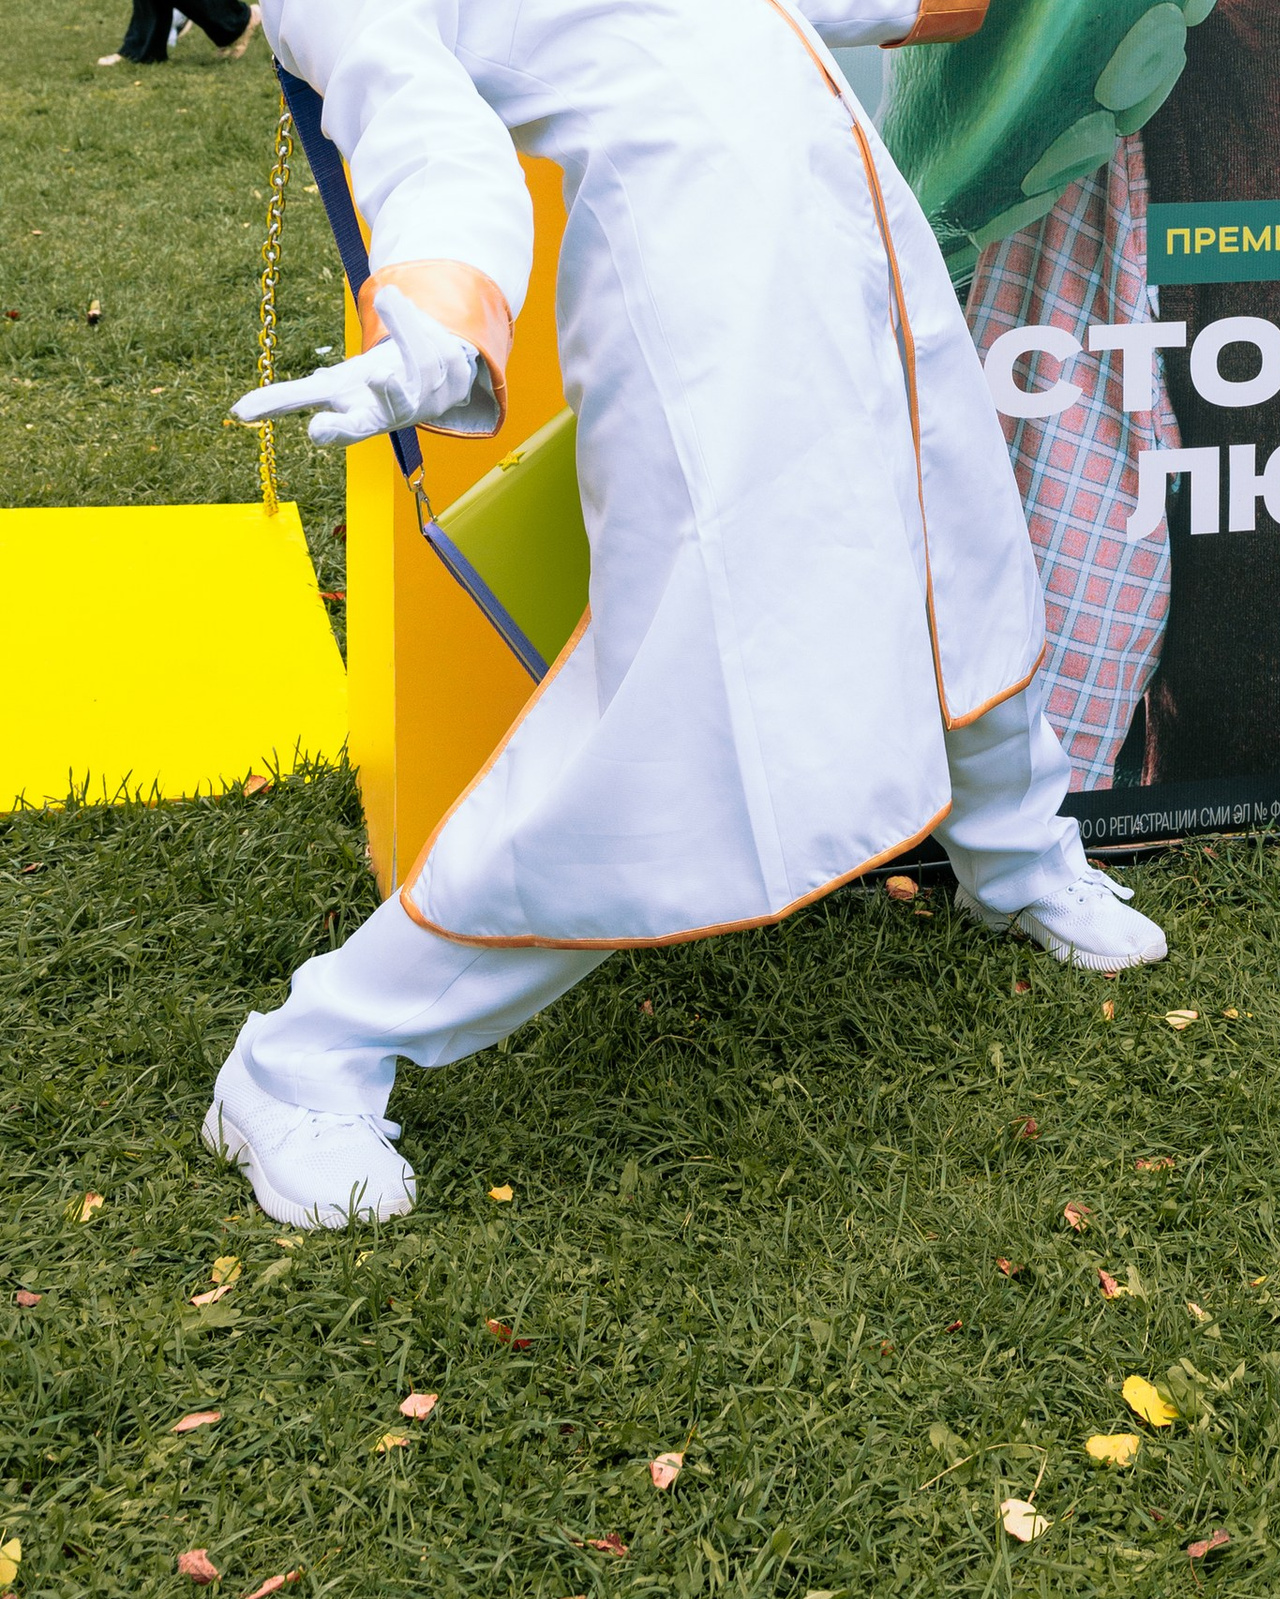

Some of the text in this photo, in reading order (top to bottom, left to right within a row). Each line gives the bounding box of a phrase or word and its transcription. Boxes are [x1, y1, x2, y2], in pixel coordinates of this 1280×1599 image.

[1095, 817, 1107, 838] О
[1109, 808, 1197, 837] РЕГИСТРАЦИИ
[1200, 804, 1231, 828] СМИ
[1233, 802, 1251, 825] ЭЛ
[1254, 801, 1268, 821] №
